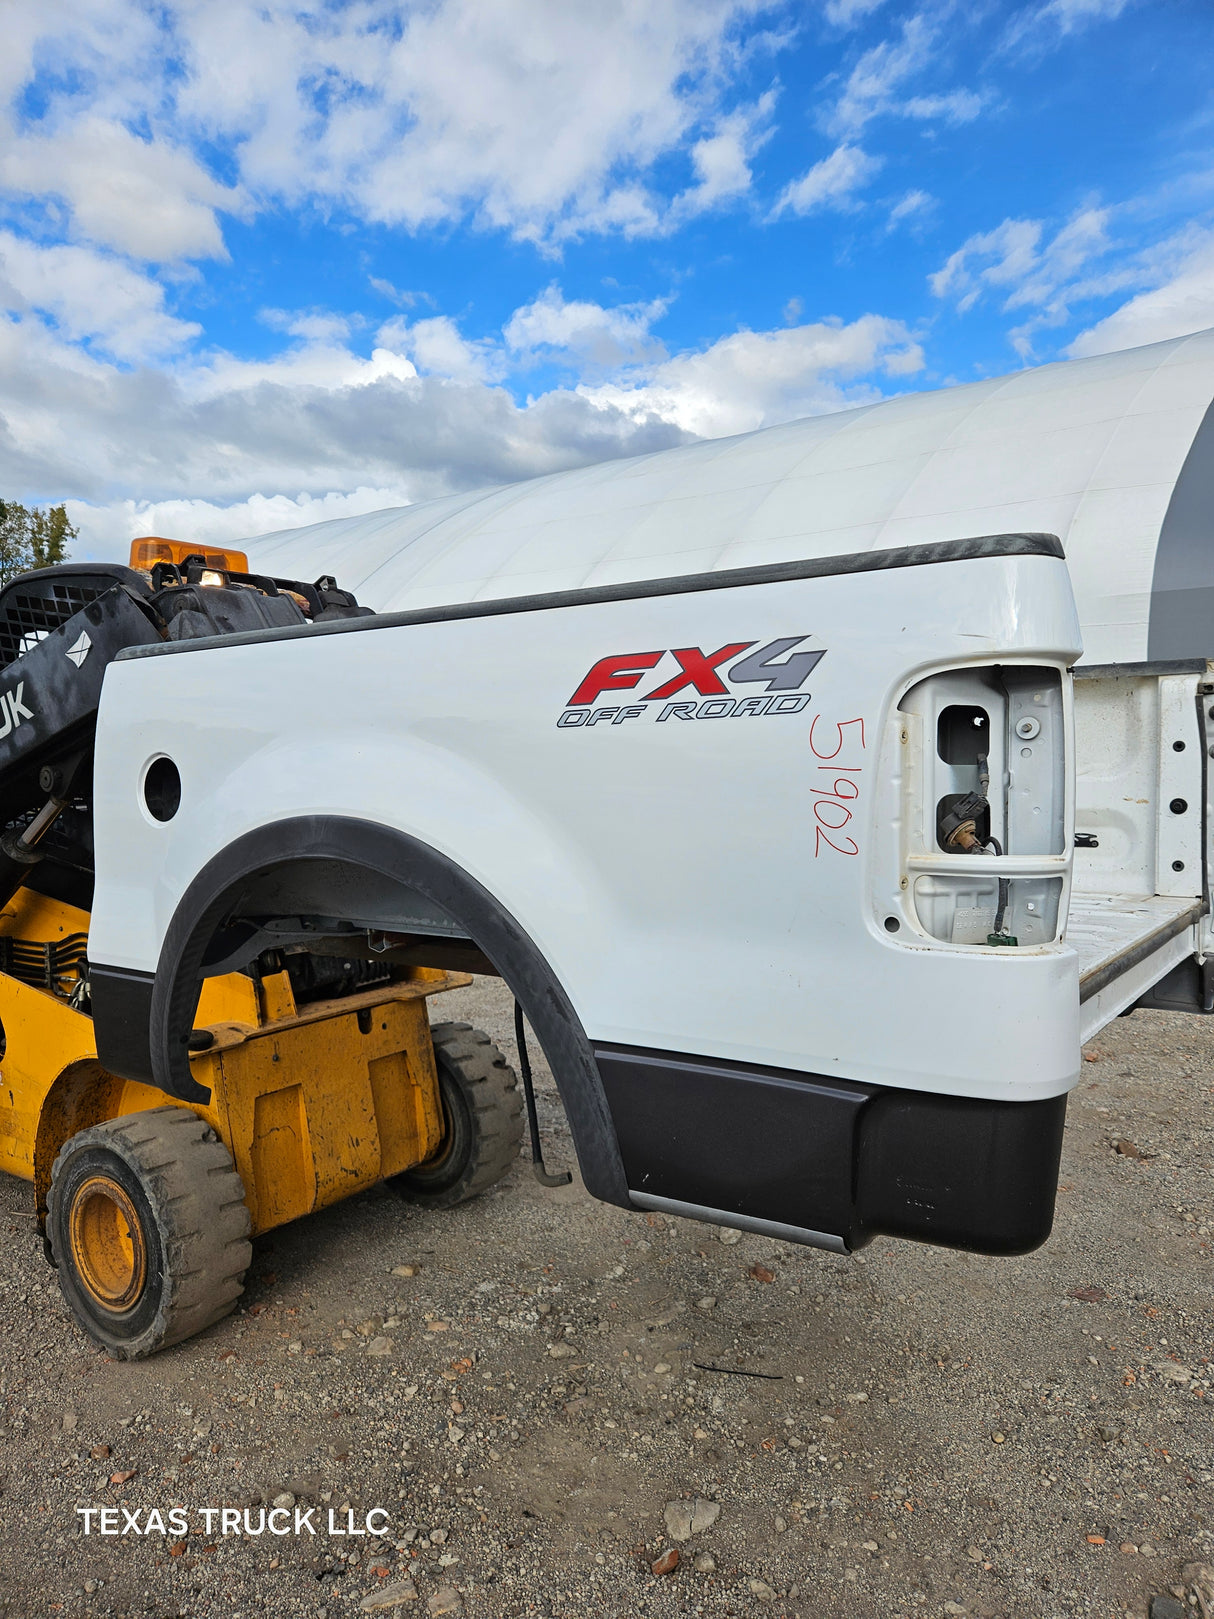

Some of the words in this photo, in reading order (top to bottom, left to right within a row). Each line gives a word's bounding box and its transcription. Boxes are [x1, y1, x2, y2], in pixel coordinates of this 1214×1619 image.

[565, 634, 829, 707] FX4
[556, 704, 649, 728] OFF
[655, 693, 812, 722] ROAD
[809, 714, 866, 858] 51902
